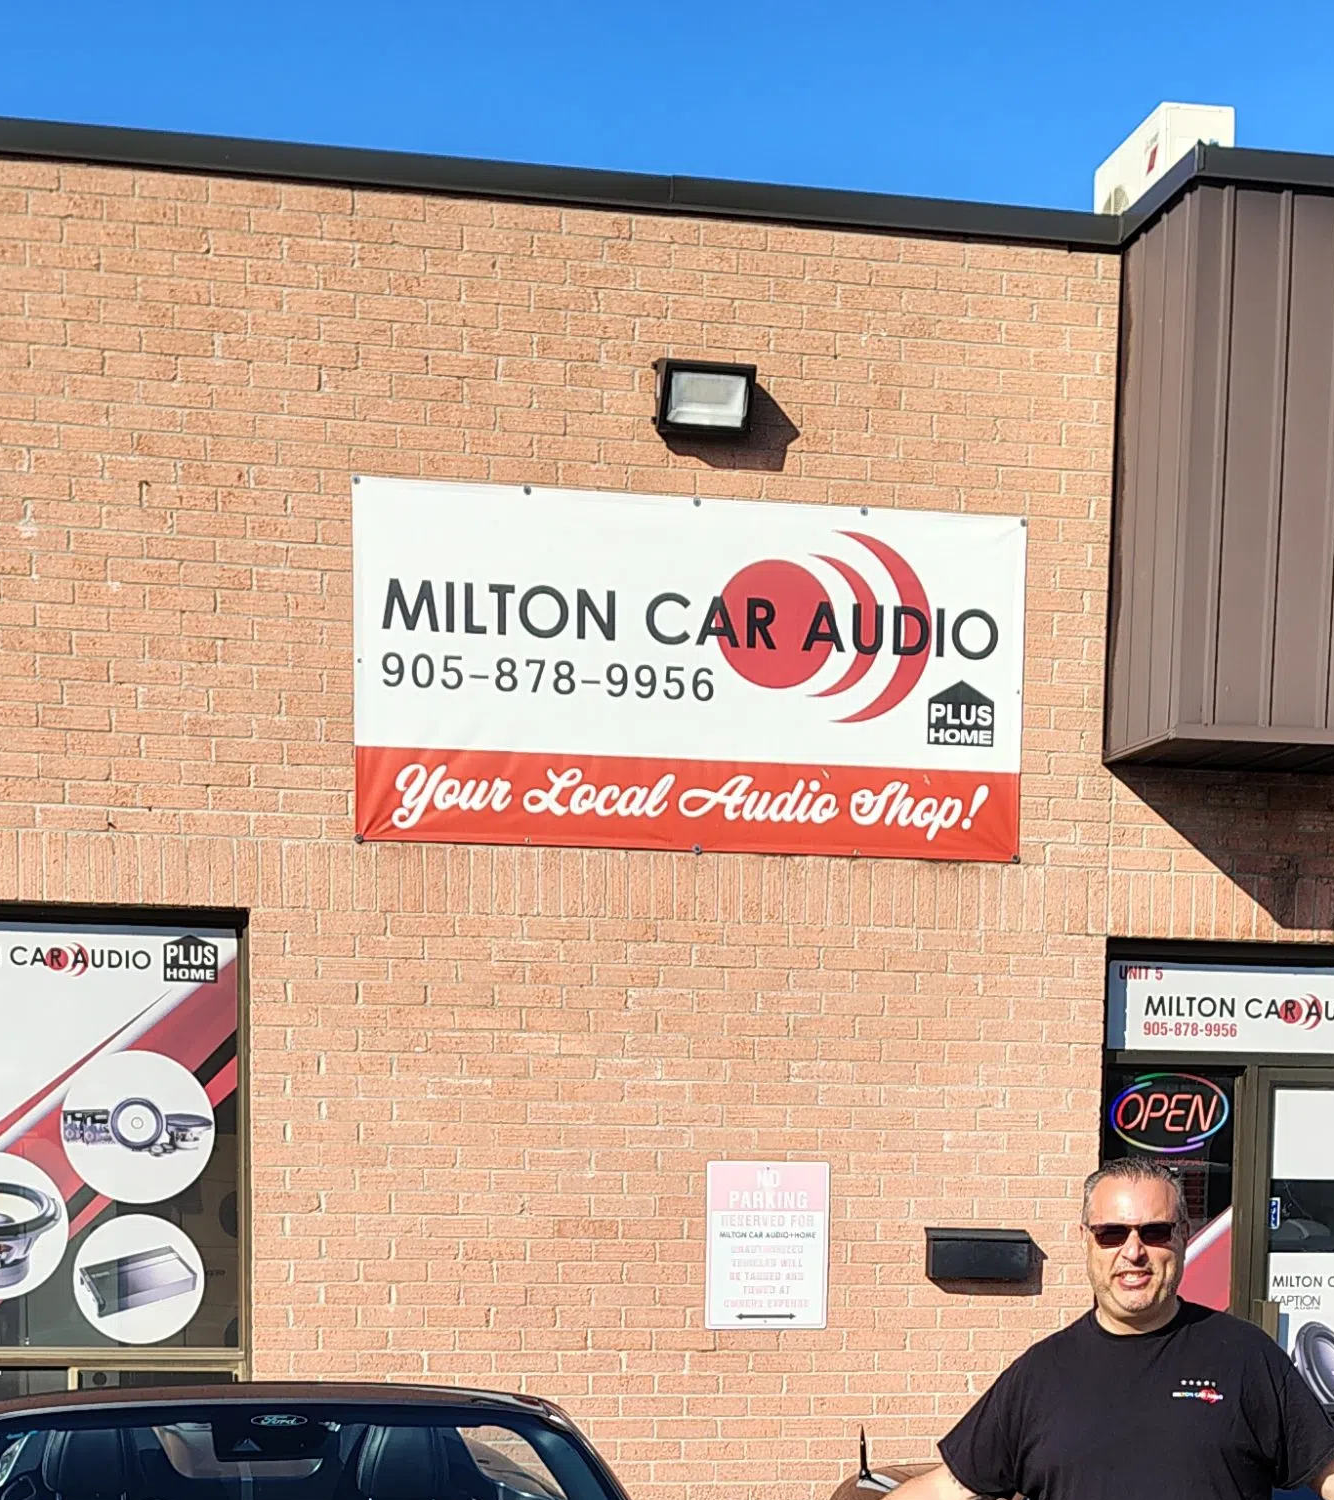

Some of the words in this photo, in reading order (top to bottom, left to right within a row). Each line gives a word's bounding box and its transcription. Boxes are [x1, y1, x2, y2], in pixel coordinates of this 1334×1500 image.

[380, 577, 617, 643] MILTON
[645, 590, 777, 651] CAR
[802, 602, 999, 660] AUDIO
[380, 651, 716, 701] 905-878-9956
[929, 702, 993, 728] PLUS
[928, 728, 993, 746] HOME
[391, 762, 513, 829] Your
[522, 768, 675, 819] Local
[678, 774, 839, 826] Audio
[849, 782, 990, 842] Shop!
[10, 945, 65, 969] CAR
[71, 946, 152, 970] AUDIO
[165, 945, 216, 966] PLUS
[166, 968, 216, 981] HOME
[1119, 965, 1150, 981] UNIT
[1155, 967, 1164, 981] 5
[1144, 995, 1236, 1018] MILTON
[1244, 998, 1297, 1020] CAR
[1143, 1021, 1238, 1038] 905-878-9956
[1116, 1092, 1218, 1132] OPEN
[757, 1170, 781, 1189] NO
[729, 1191, 808, 1209] PARKING
[790, 1215, 815, 1228] FOR
[748, 1231, 764, 1239] CAR
[1272, 1275, 1323, 1288] MILTON
[1271, 1295, 1321, 1306] KAPTION
[260, 1416, 297, 1425] Ford
